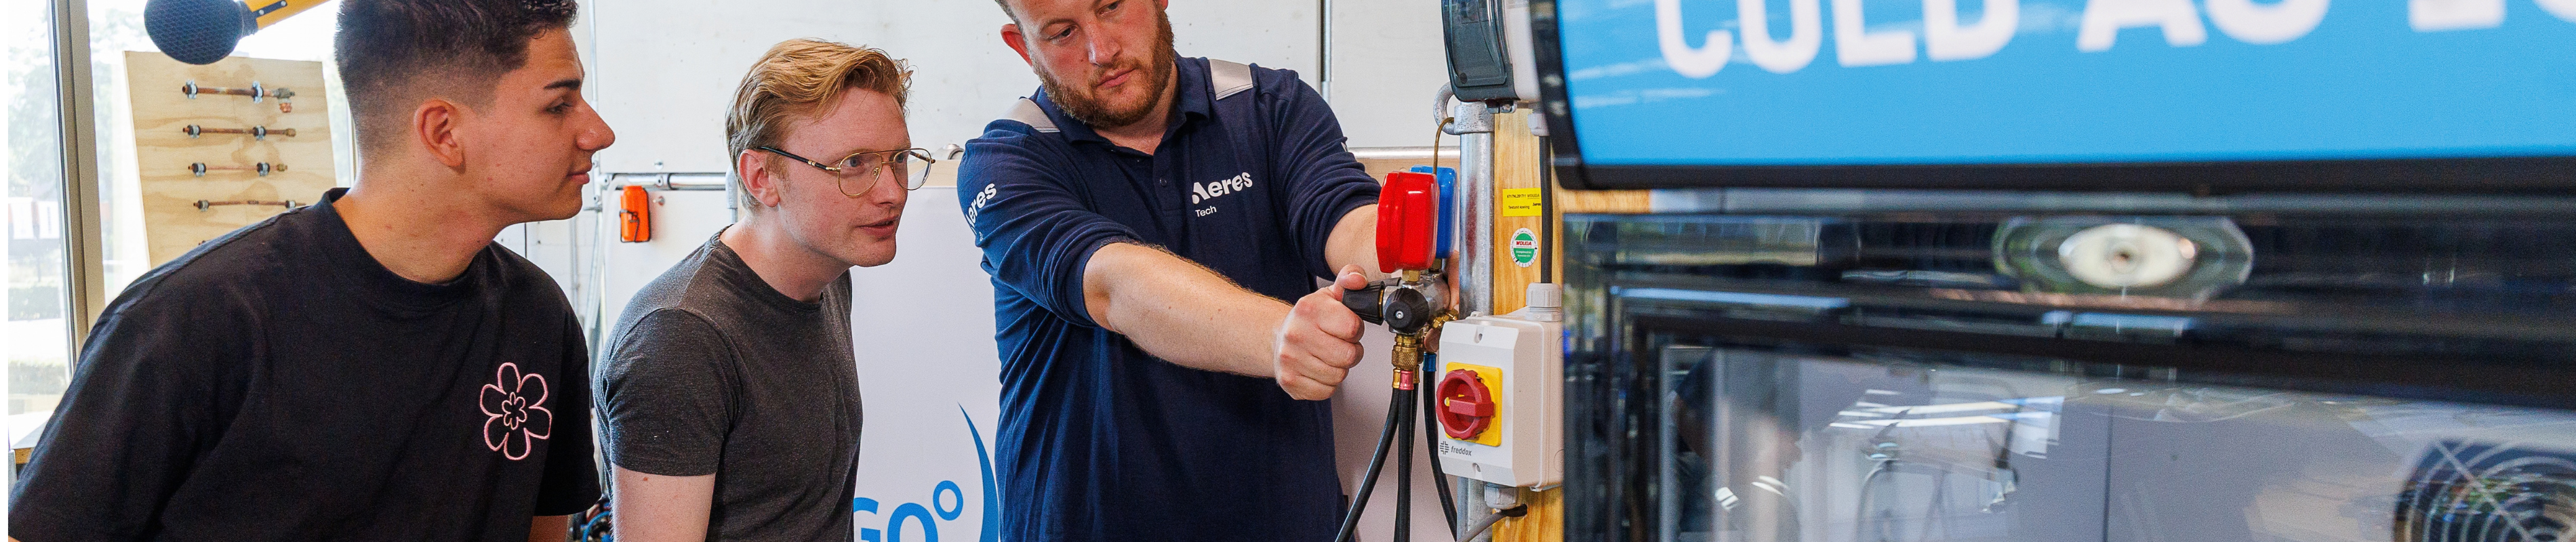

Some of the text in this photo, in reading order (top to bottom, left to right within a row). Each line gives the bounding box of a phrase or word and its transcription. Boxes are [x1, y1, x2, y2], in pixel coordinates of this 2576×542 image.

[1192, 171, 1253, 204] Aeres
[1195, 205, 1217, 217] Tech
[1451, 446, 1472, 456] freddox
